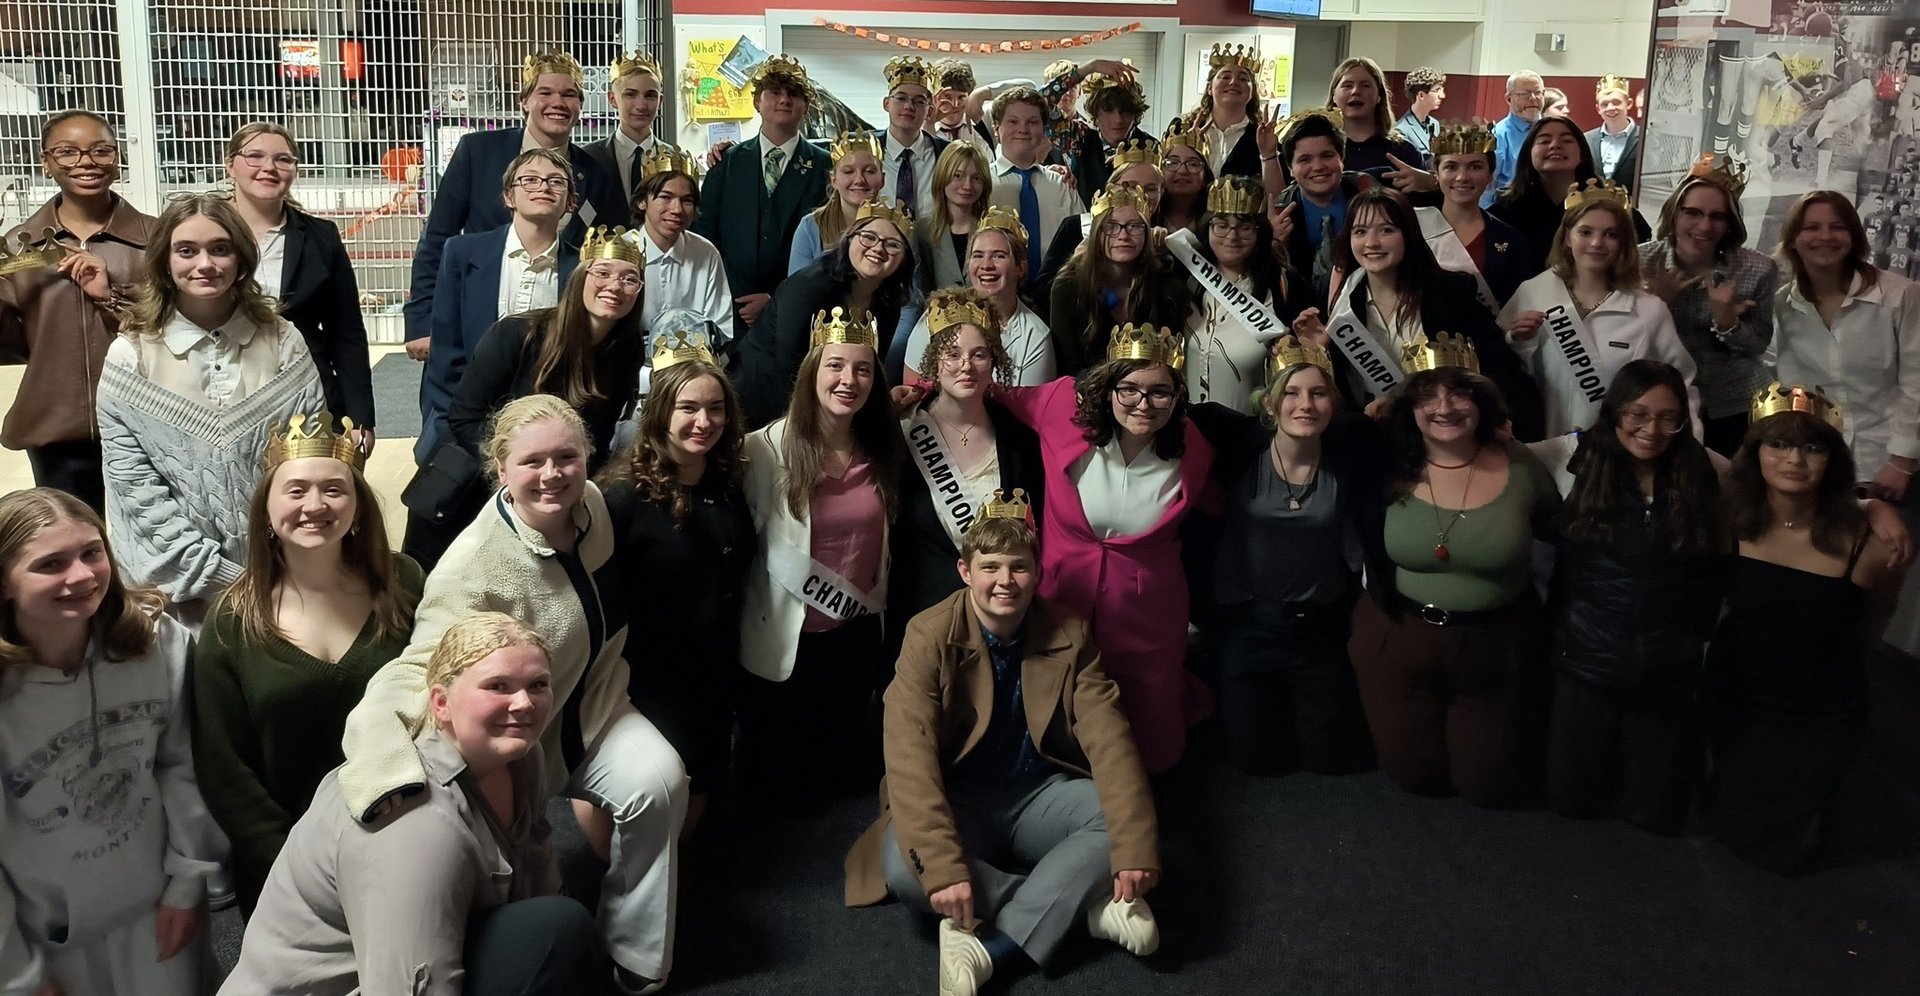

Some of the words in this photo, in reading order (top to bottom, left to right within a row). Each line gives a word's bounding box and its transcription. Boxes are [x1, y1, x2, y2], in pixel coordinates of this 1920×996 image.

[691, 42, 725, 54] What's
[1191, 253, 1274, 332] CHAMPION
[1890, 253, 1907, 269] 29
[1336, 323, 1398, 393] CHAMPI
[1545, 304, 1606, 403] CHAMPION
[909, 424, 976, 534] CHAMPION
